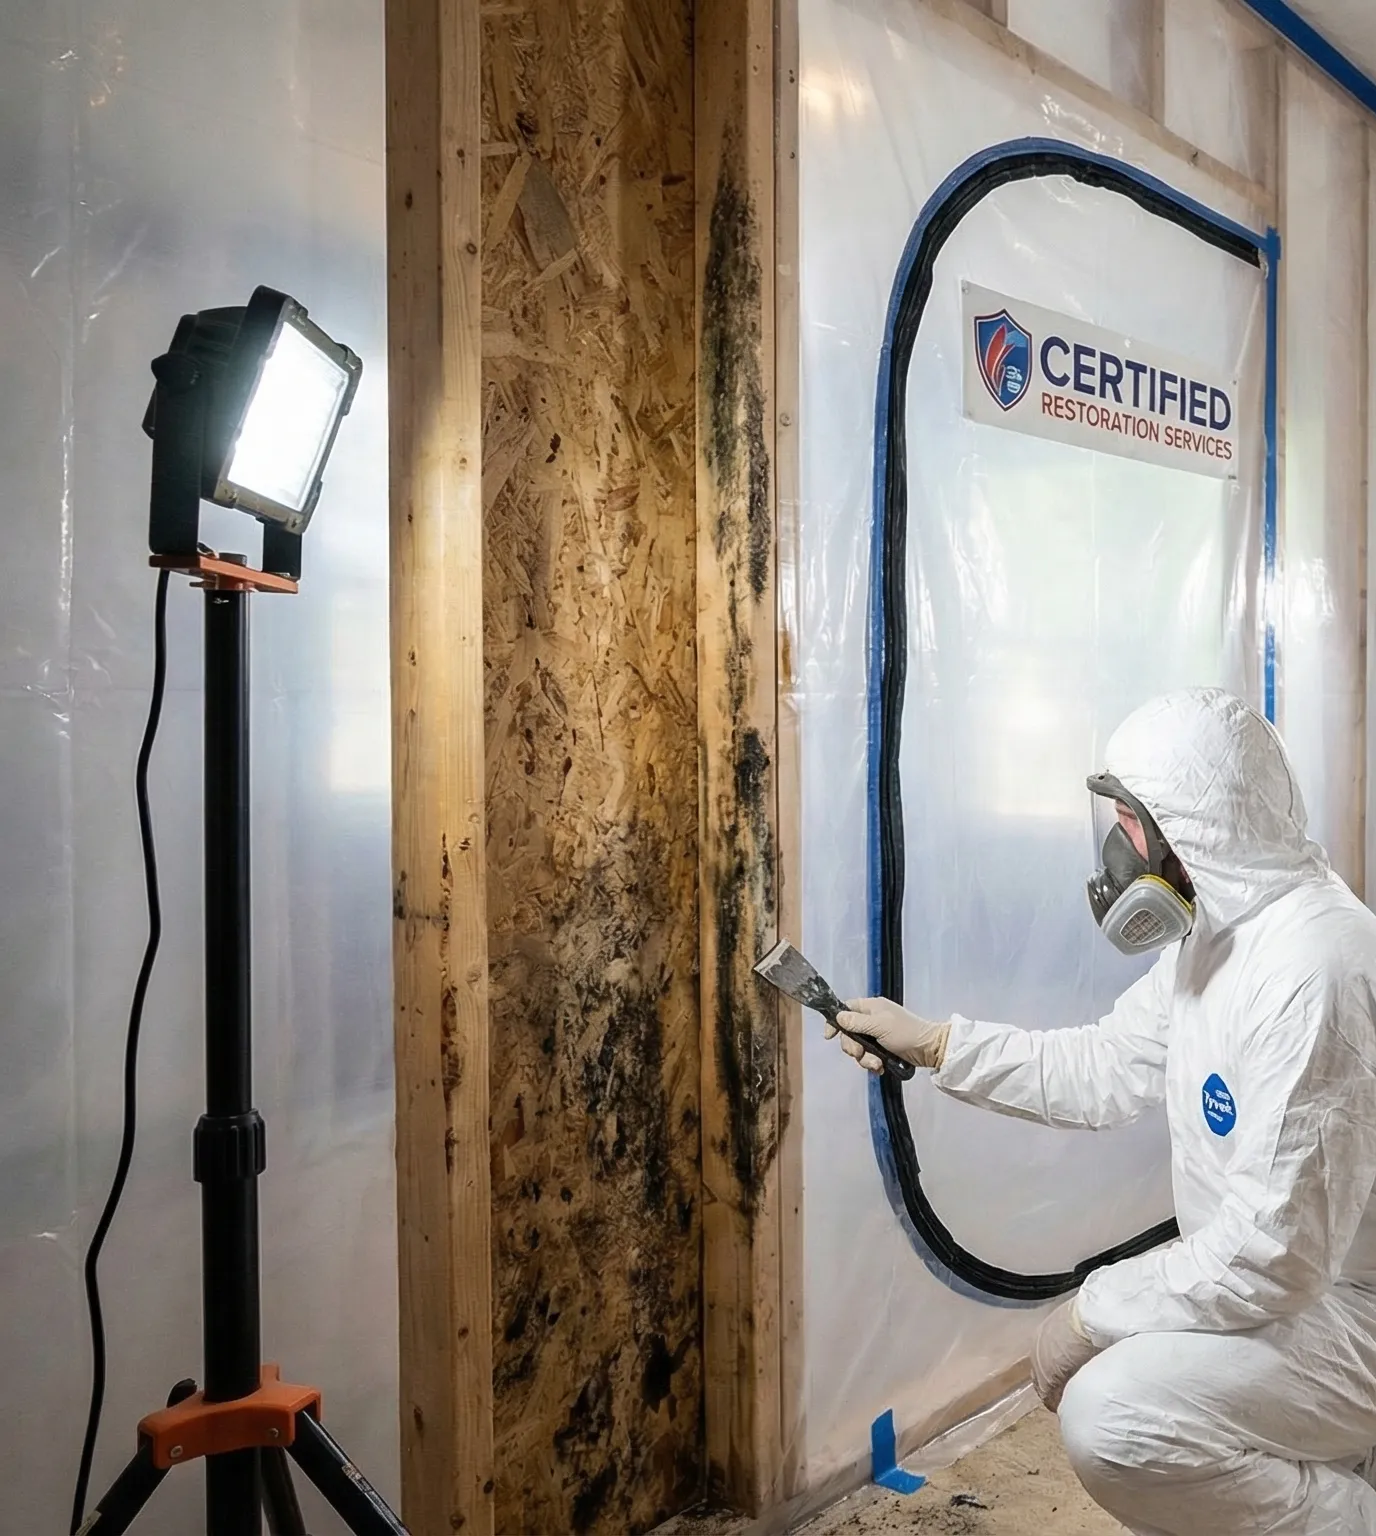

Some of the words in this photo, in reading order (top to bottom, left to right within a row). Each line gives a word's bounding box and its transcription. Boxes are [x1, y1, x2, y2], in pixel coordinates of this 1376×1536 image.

[1040, 336, 1231, 431] CERTIFIED
[1041, 392, 1159, 443] RESTORATION
[1164, 426, 1232, 460] SERVICES
